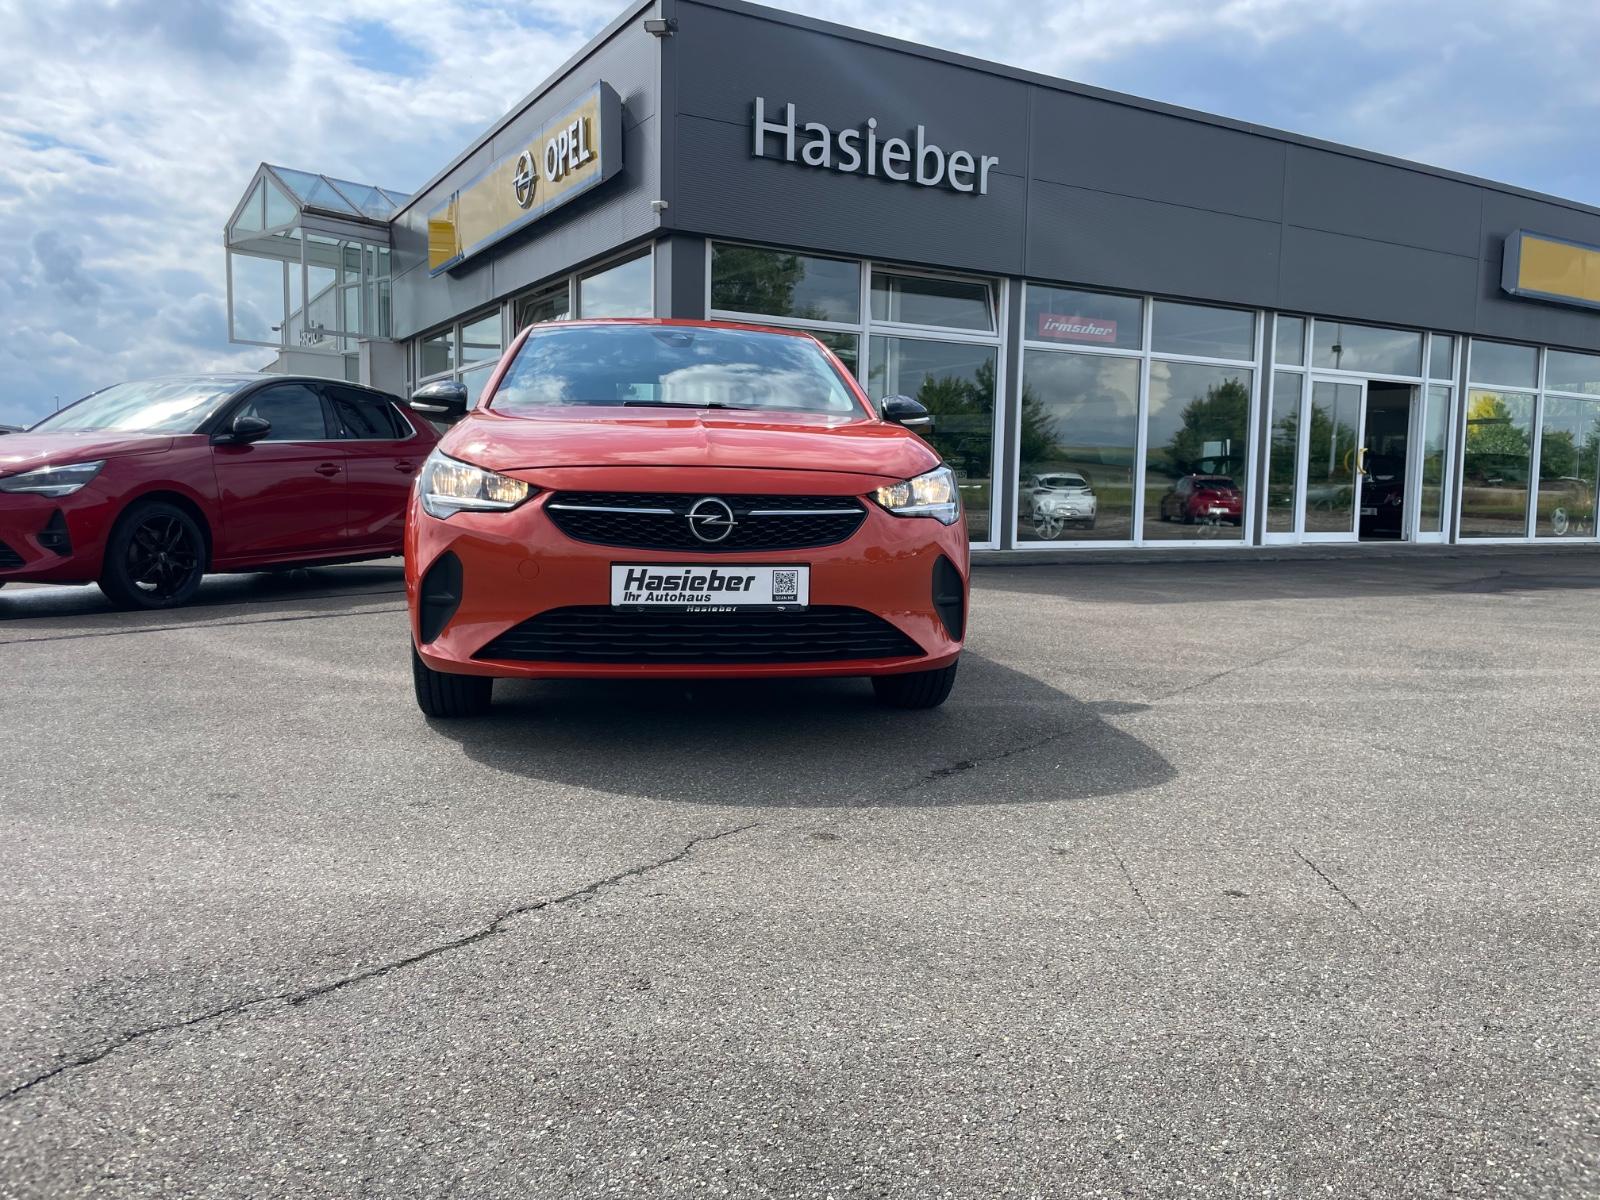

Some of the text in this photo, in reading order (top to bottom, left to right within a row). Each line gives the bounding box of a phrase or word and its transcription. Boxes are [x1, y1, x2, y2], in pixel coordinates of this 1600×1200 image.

[544, 117, 590, 182] OPEL
[754, 97, 999, 195] Hasieber
[1043, 318, 1113, 336] irmscher
[623, 569, 755, 592] Hasieber
[623, 592, 712, 602] Ihr Autohaus
